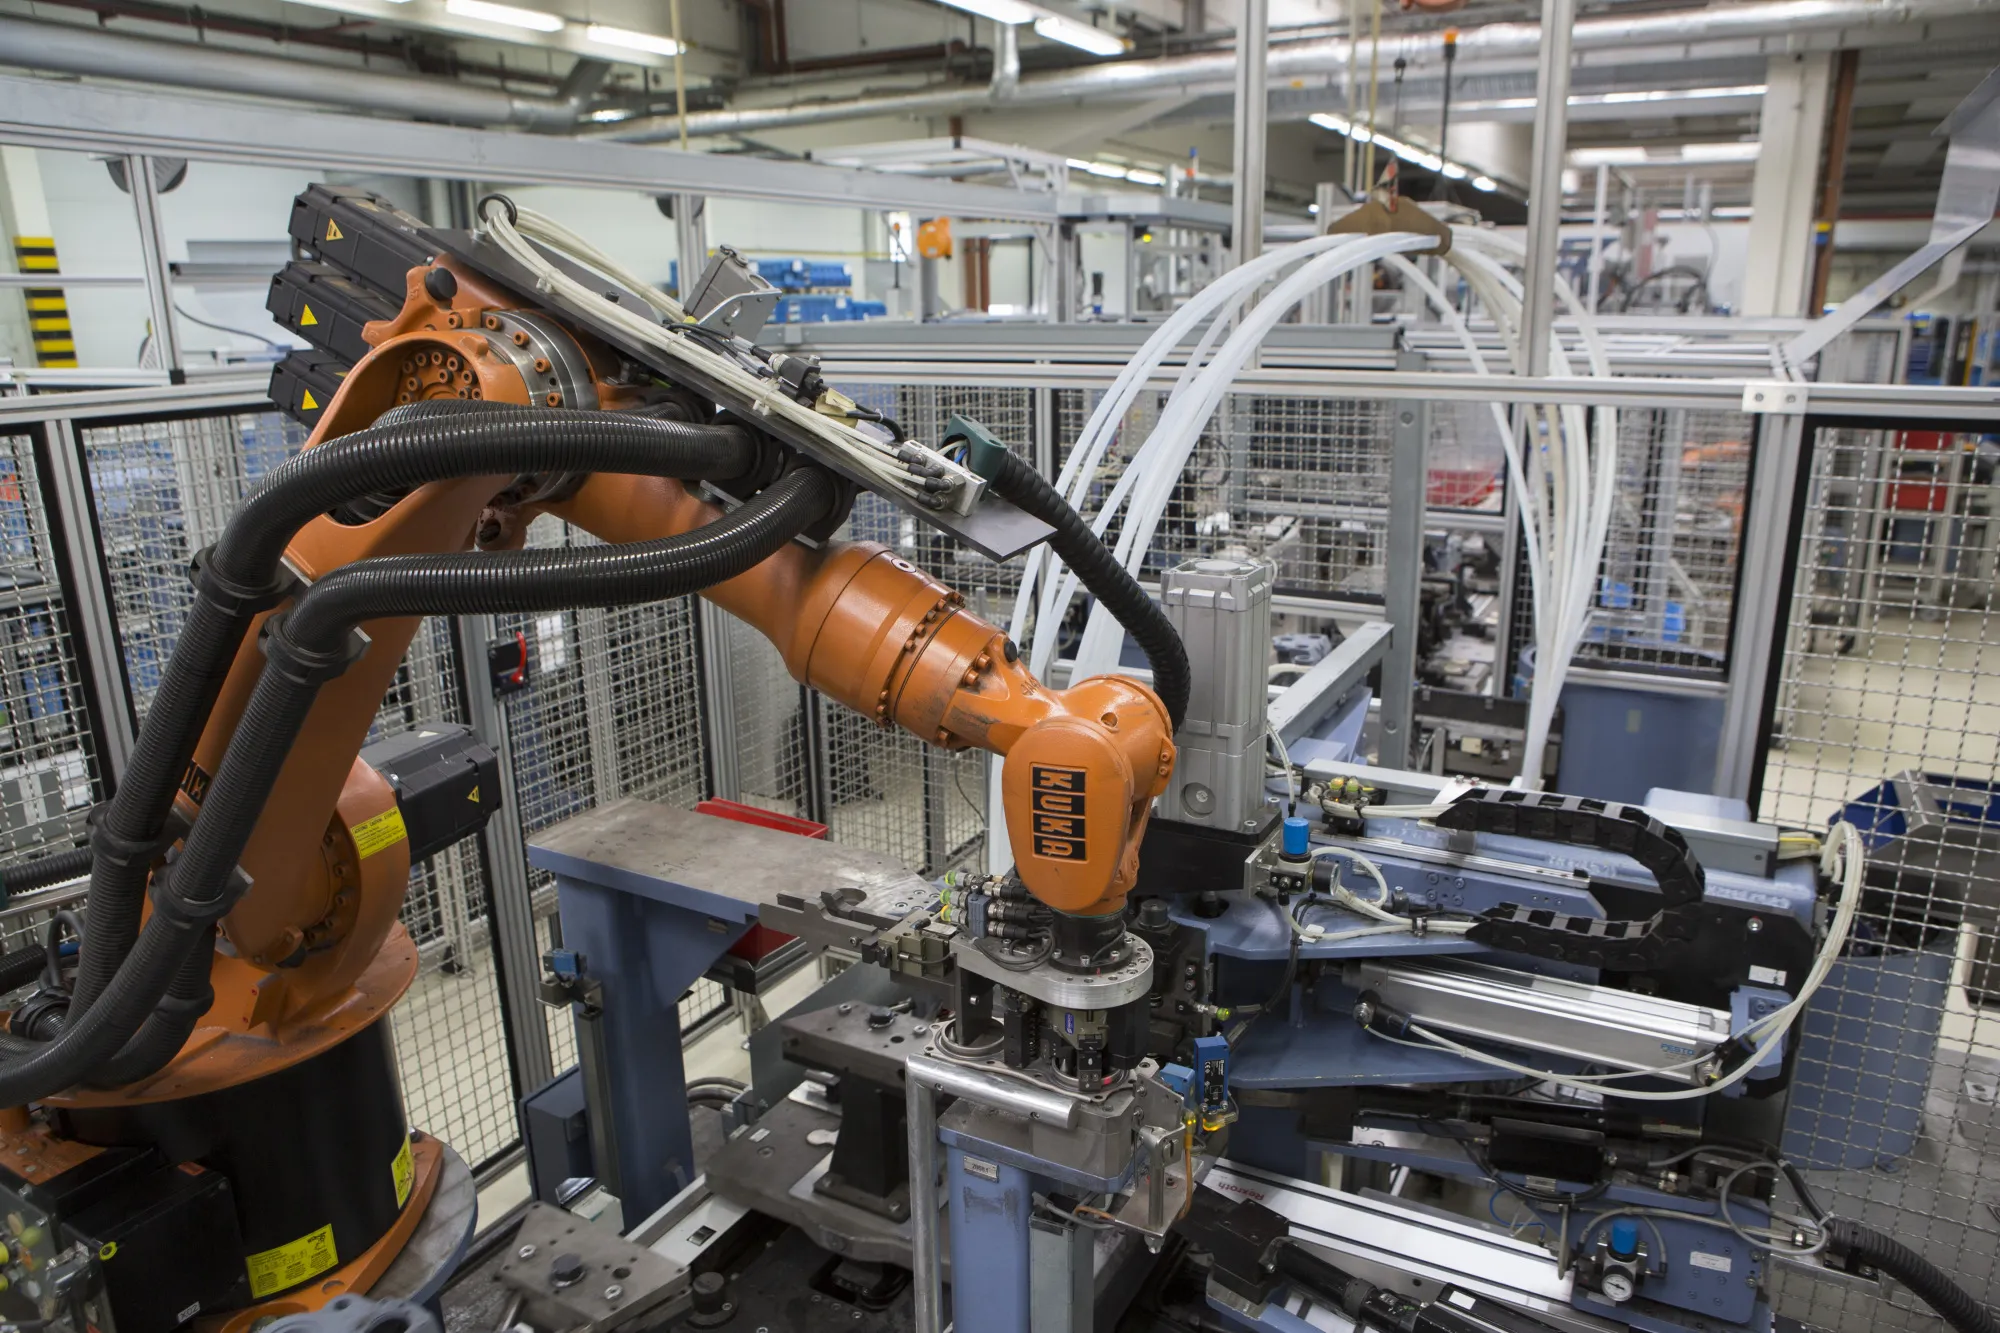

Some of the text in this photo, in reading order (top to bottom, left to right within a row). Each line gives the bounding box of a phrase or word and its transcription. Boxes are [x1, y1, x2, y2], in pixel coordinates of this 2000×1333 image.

[1039, 770, 1073, 856] KUKA
[1661, 1043, 1696, 1056] FESTO
[1218, 1181, 1265, 1201] Rexroth
